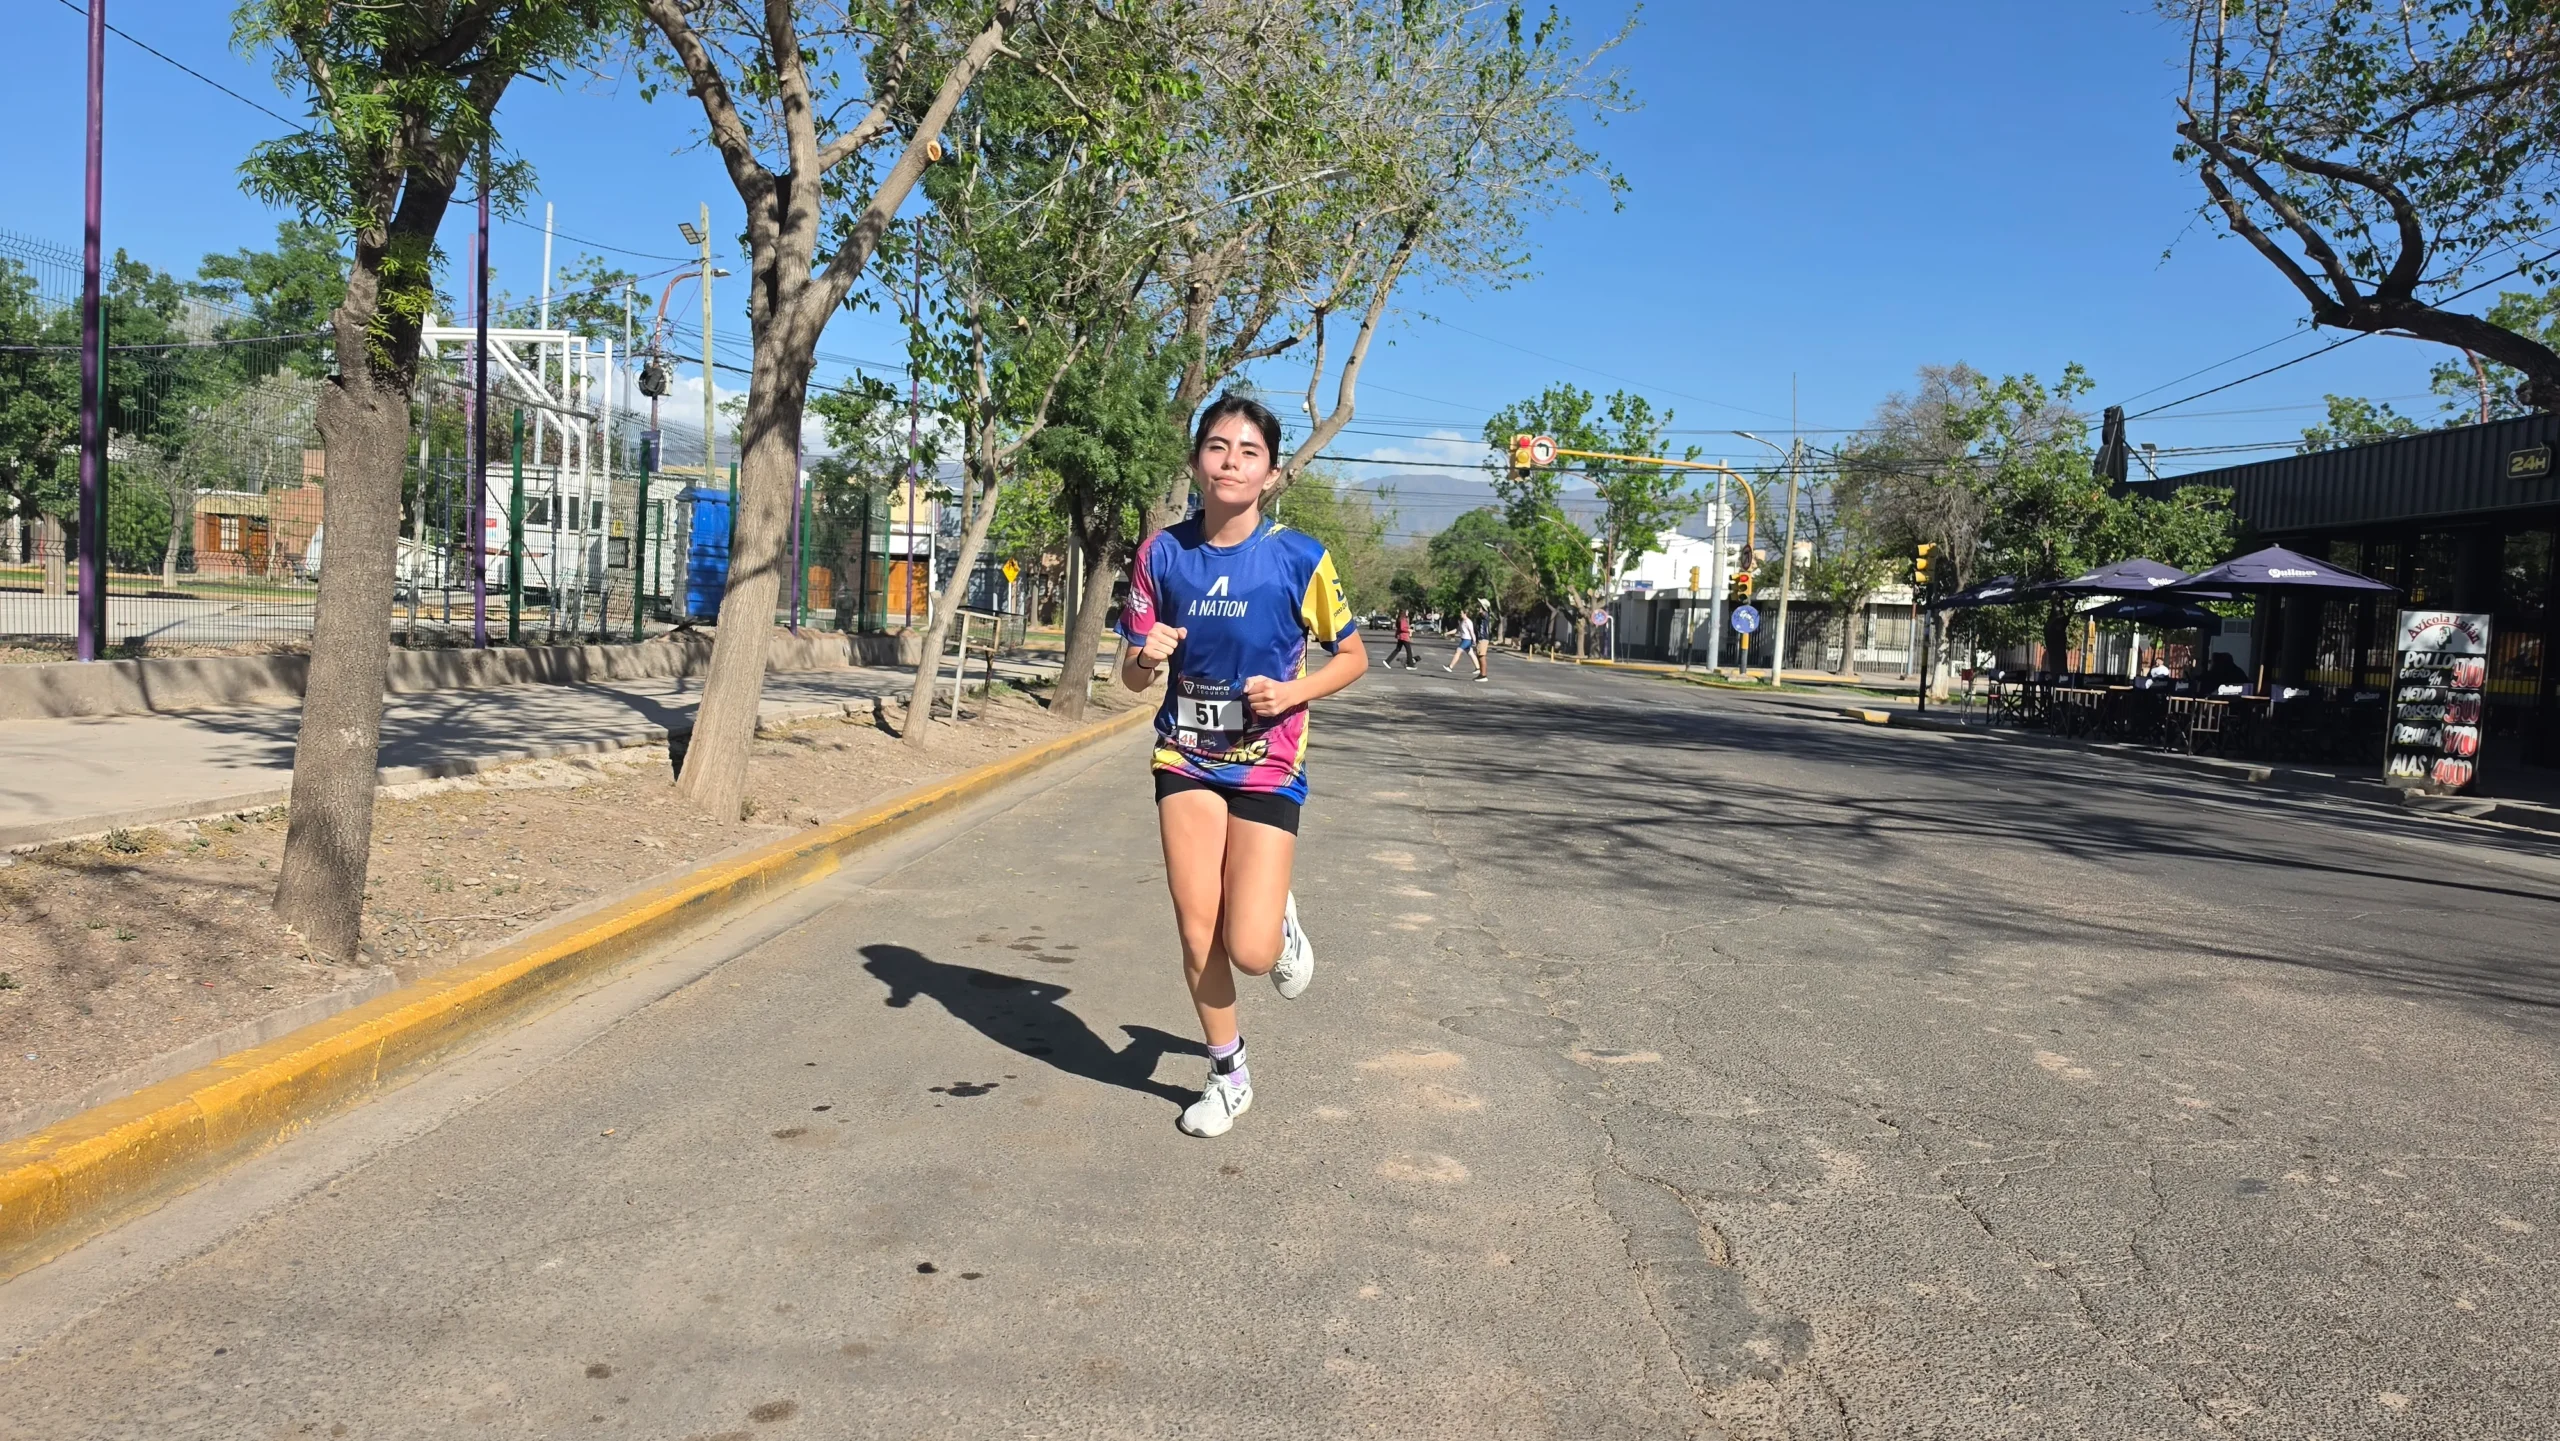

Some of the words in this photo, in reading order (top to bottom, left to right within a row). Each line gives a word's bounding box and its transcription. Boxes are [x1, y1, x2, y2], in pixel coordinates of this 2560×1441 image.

[2511, 456, 2546, 473] 24H
[2268, 568, 2318, 578] Quilmes
[1187, 600, 1197, 616] A
[1198, 600, 1249, 618] NATION
[2407, 613, 2450, 642] Avícola
[2404, 651, 2455, 669] POLLO
[1196, 684, 1231, 692] TRIUNFO
[2398, 686, 2437, 702] MEDIO
[1195, 702, 1220, 727] 51
[2396, 703, 2445, 720] TRASERO
[2391, 722, 2443, 747] PECHUGA
[2388, 752, 2428, 777] ALAS
[2431, 757, 2473, 786] 4000
